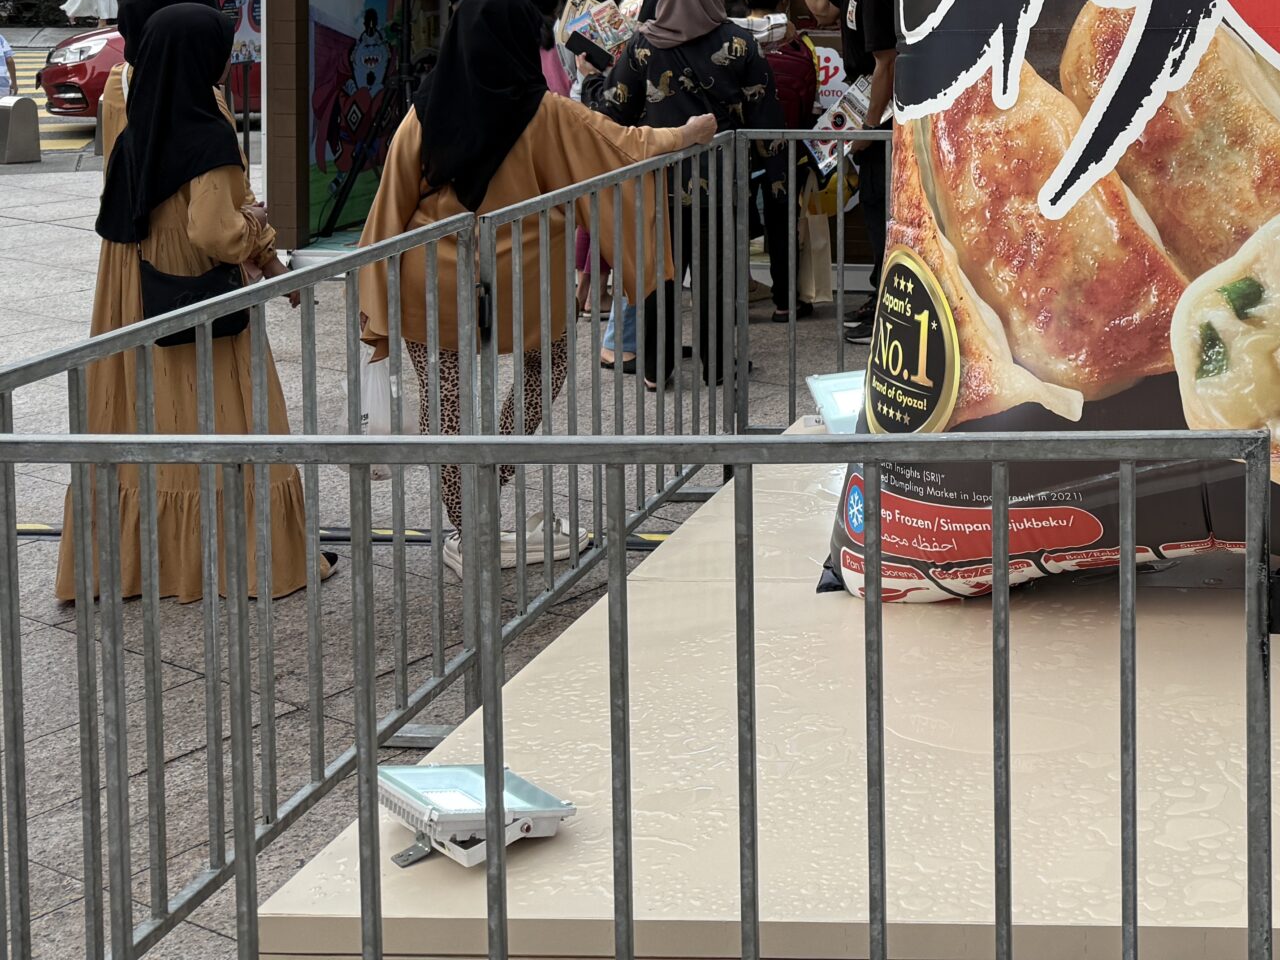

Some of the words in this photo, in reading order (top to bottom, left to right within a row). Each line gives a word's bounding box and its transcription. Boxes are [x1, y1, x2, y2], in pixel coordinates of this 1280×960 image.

[882, 286, 912, 317] Japan's
[888, 386, 895, 398] of
[896, 389, 927, 411] Gyoza!
[894, 461, 921, 479] Insights
[890, 475, 924, 497] Dumpling
[926, 485, 957, 500] Market
[960, 491, 969, 501] in
[972, 491, 992, 504] Jap
[1008, 491, 1036, 503] result
[1037, 491, 1047, 502] in
[1050, 491, 1083, 503] 2021)
[1008, 515, 1075, 532] ejukbeku/
[845, 555, 861, 571] Pan
[1064, 550, 1120, 561] Boil/Rebu
